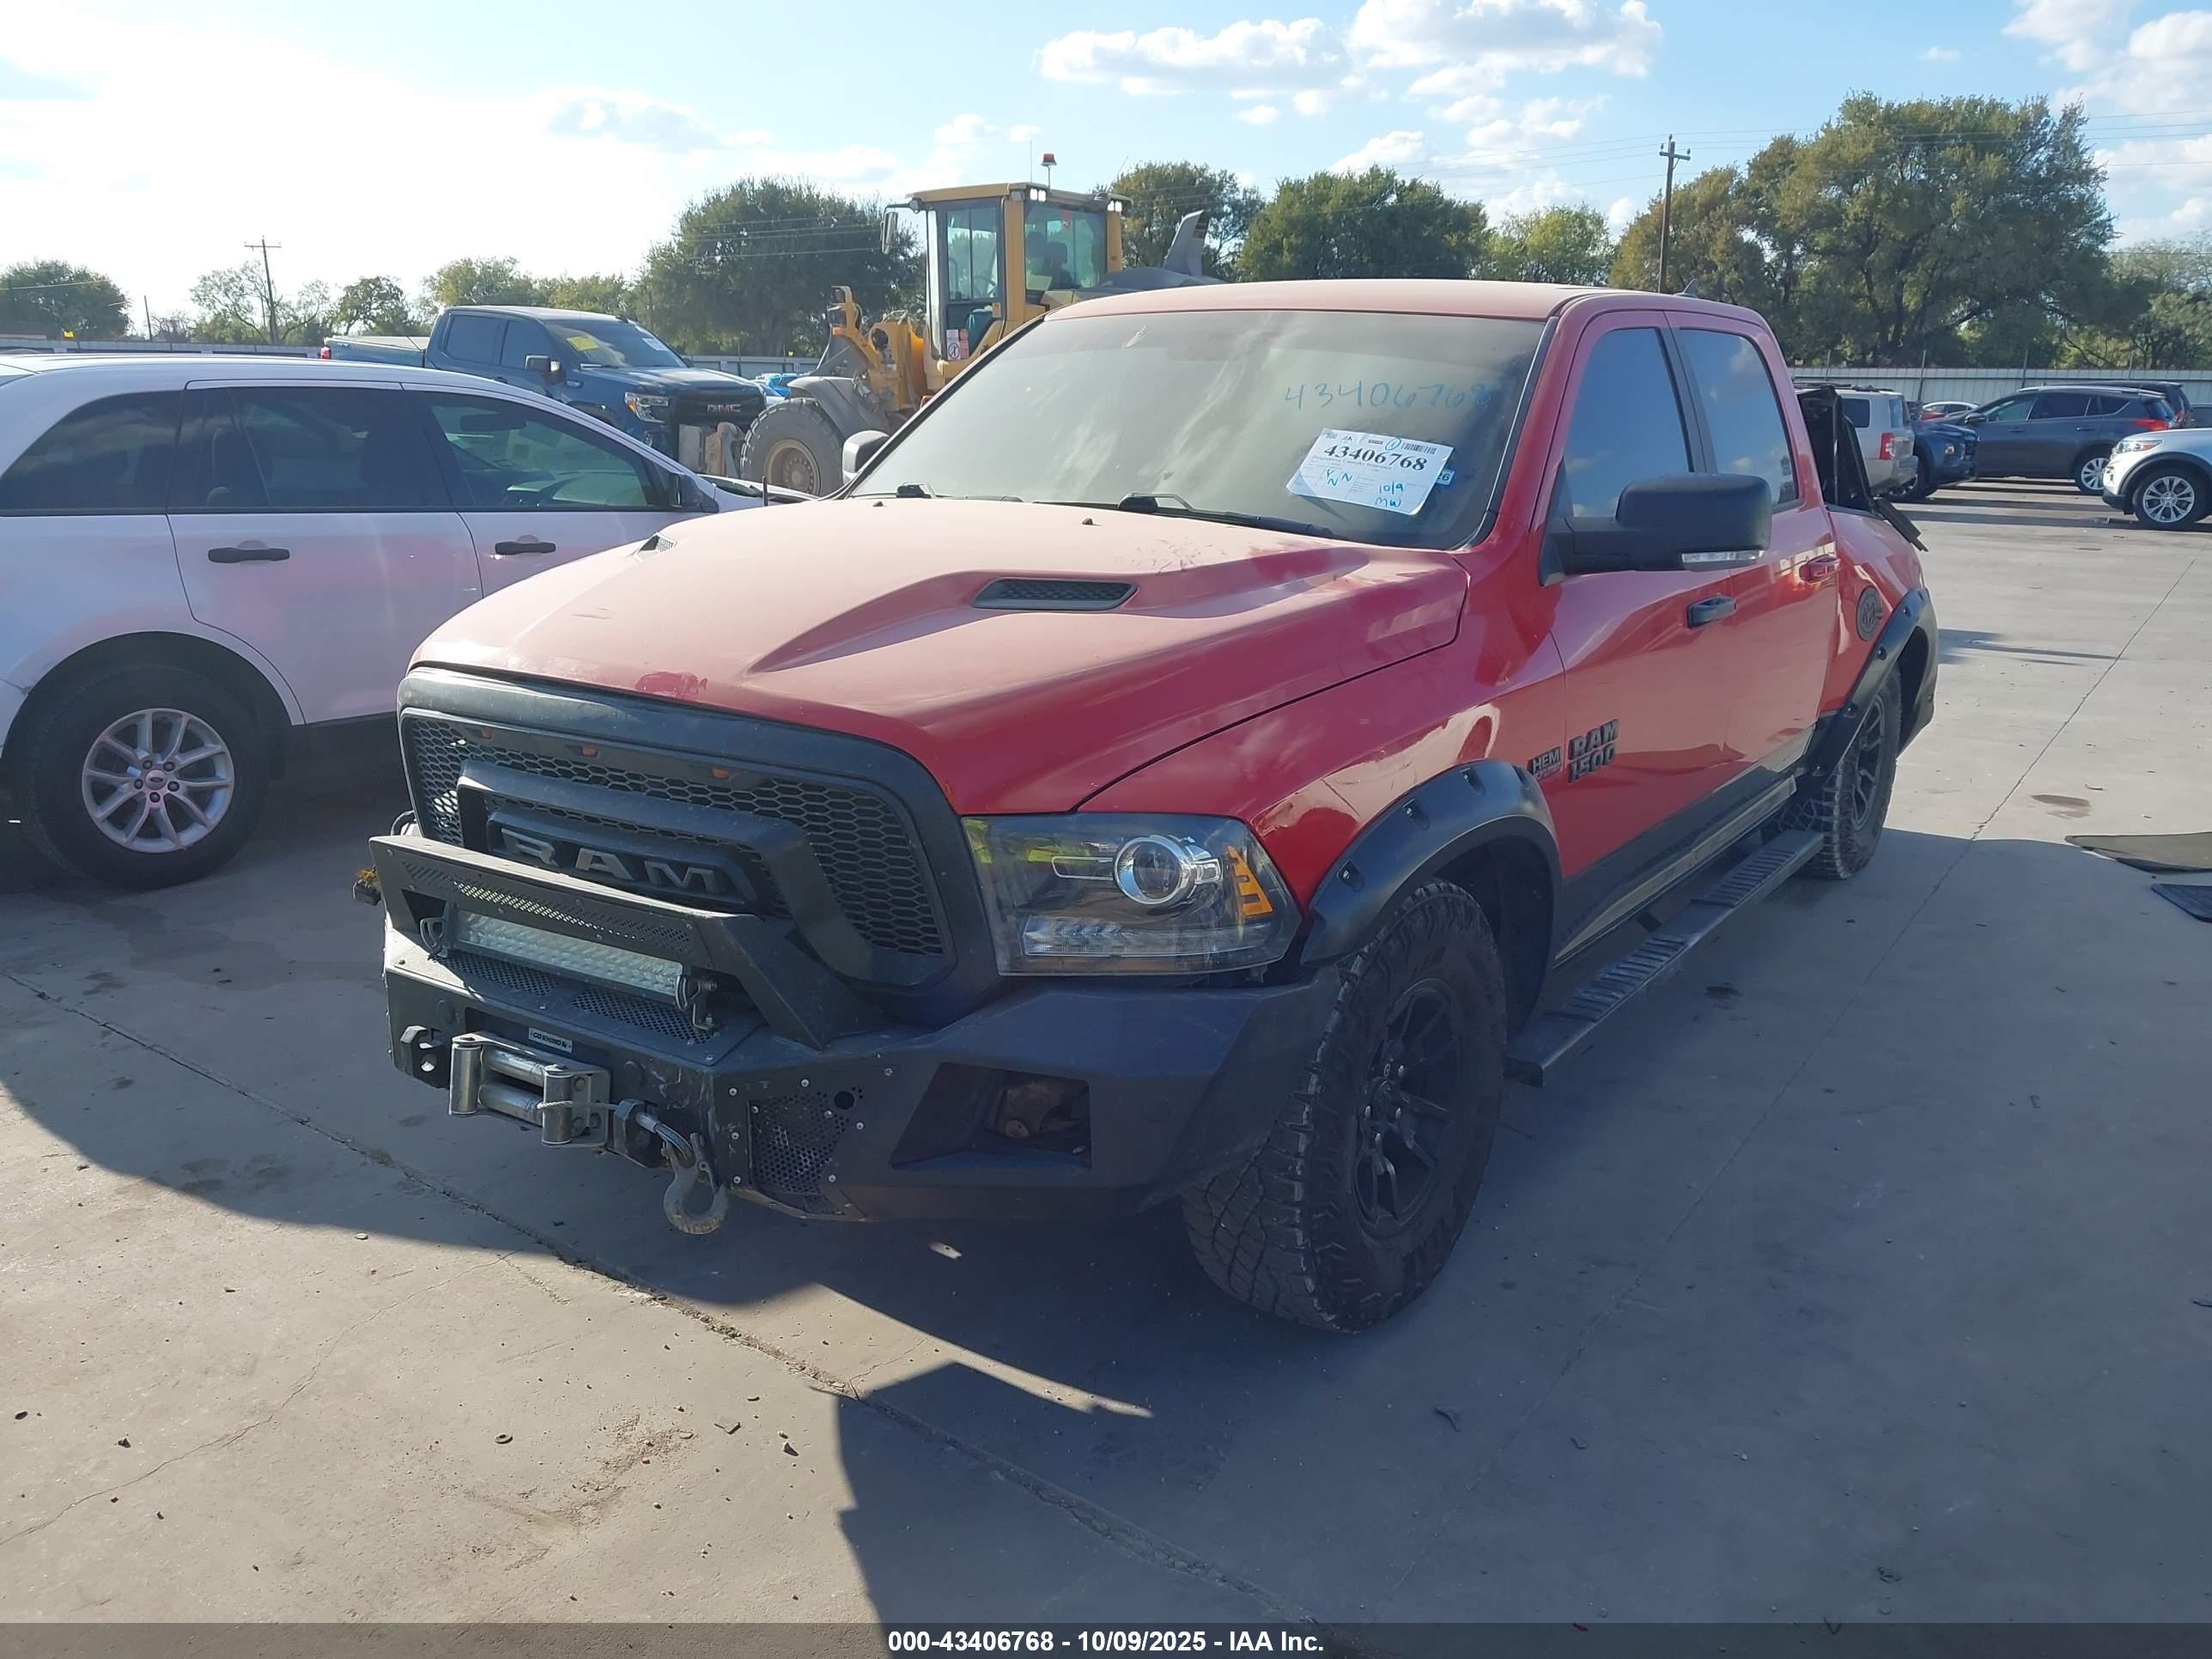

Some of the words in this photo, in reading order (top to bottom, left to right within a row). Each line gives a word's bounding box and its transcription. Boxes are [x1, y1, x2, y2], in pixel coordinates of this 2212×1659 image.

[707, 404, 742, 413] GMC
[1323, 444, 1428, 471] 43406768
[1568, 719, 1620, 760] RAM
[1568, 743, 1616, 783] 1500
[501, 827, 730, 895] RAM
